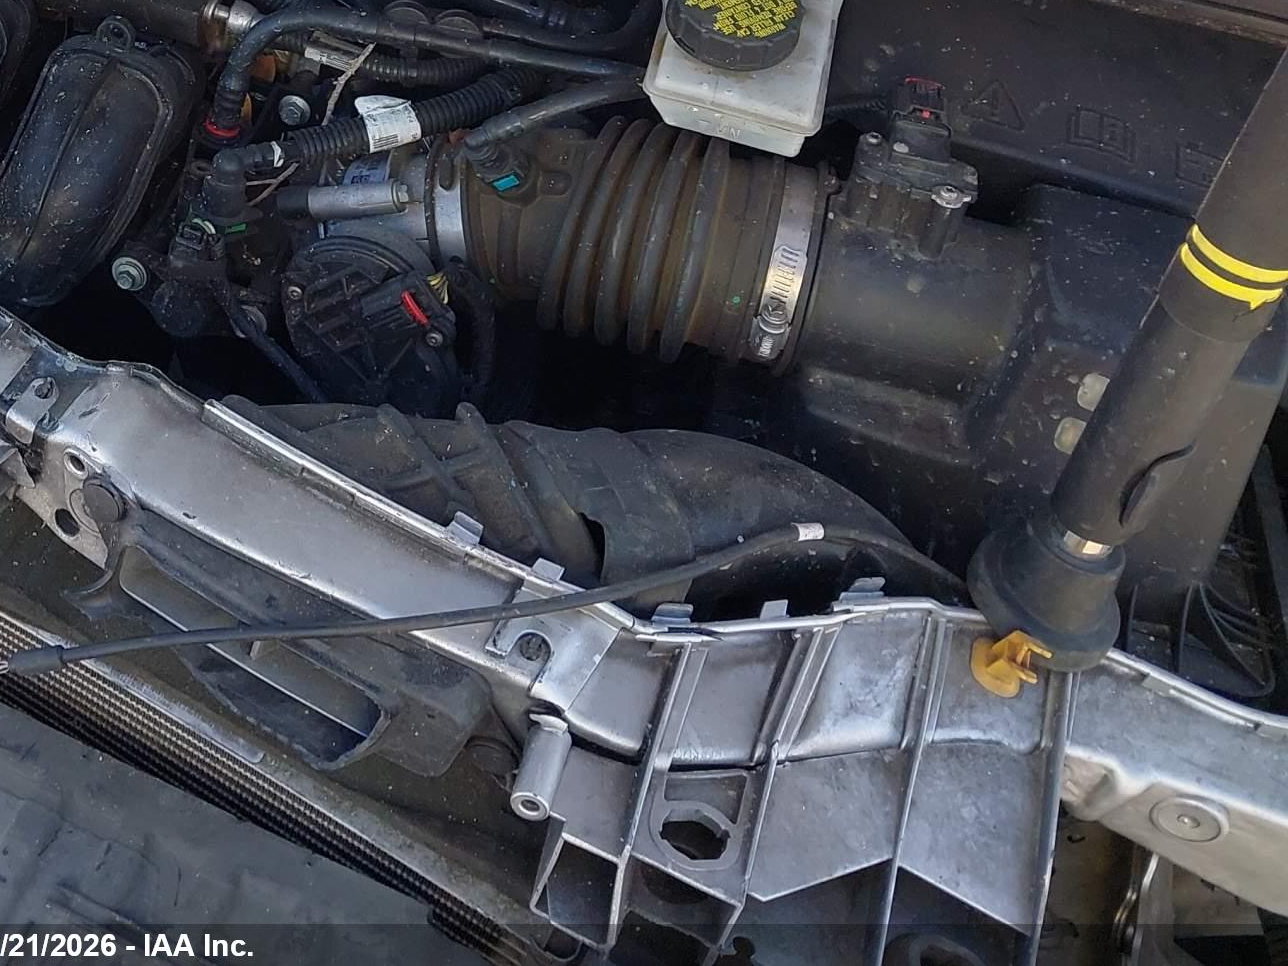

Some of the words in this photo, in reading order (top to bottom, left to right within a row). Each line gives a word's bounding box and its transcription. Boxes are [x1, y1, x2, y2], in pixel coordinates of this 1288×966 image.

[760, 0, 776, 10] DOT
[771, 1, 797, 15] BEFORE
[734, 8, 755, 21] FLUID
[720, 24, 737, 35] USE
[749, 17, 774, 32] FILLER
